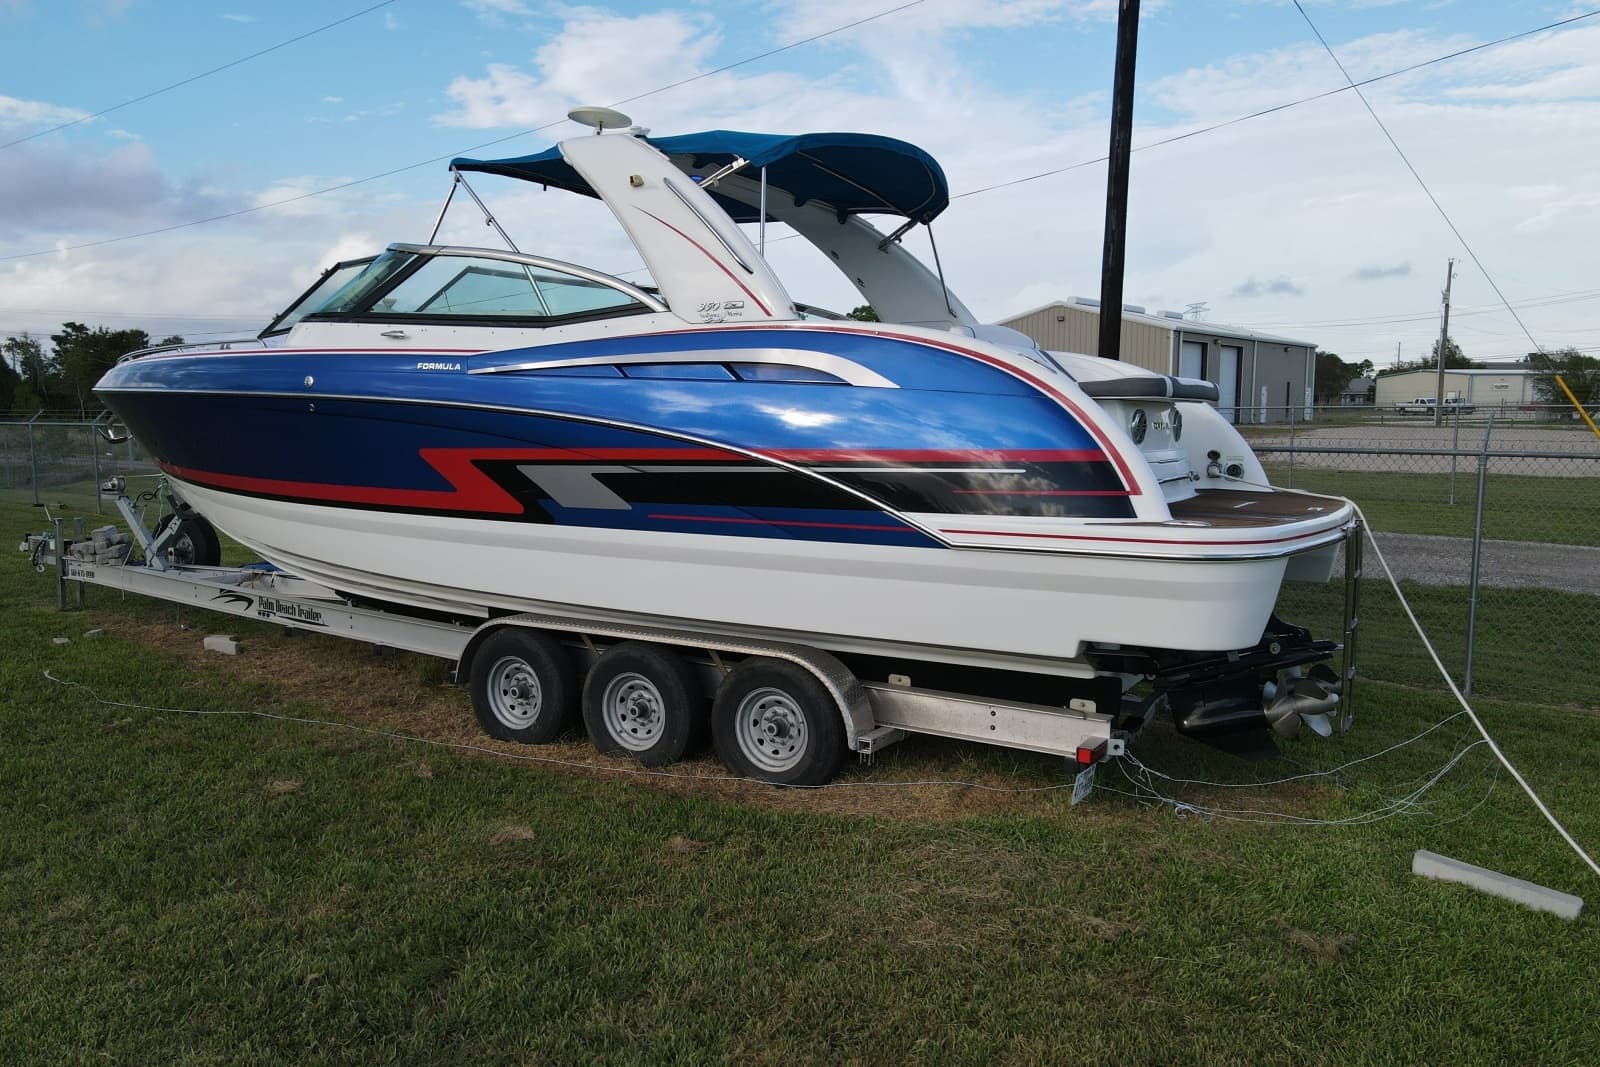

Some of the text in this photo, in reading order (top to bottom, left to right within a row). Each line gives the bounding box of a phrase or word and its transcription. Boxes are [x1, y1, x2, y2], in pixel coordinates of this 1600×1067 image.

[417, 362, 461, 371] FORMULA
[258, 595, 275, 611] Palm
[297, 604, 322, 622] Trailer
